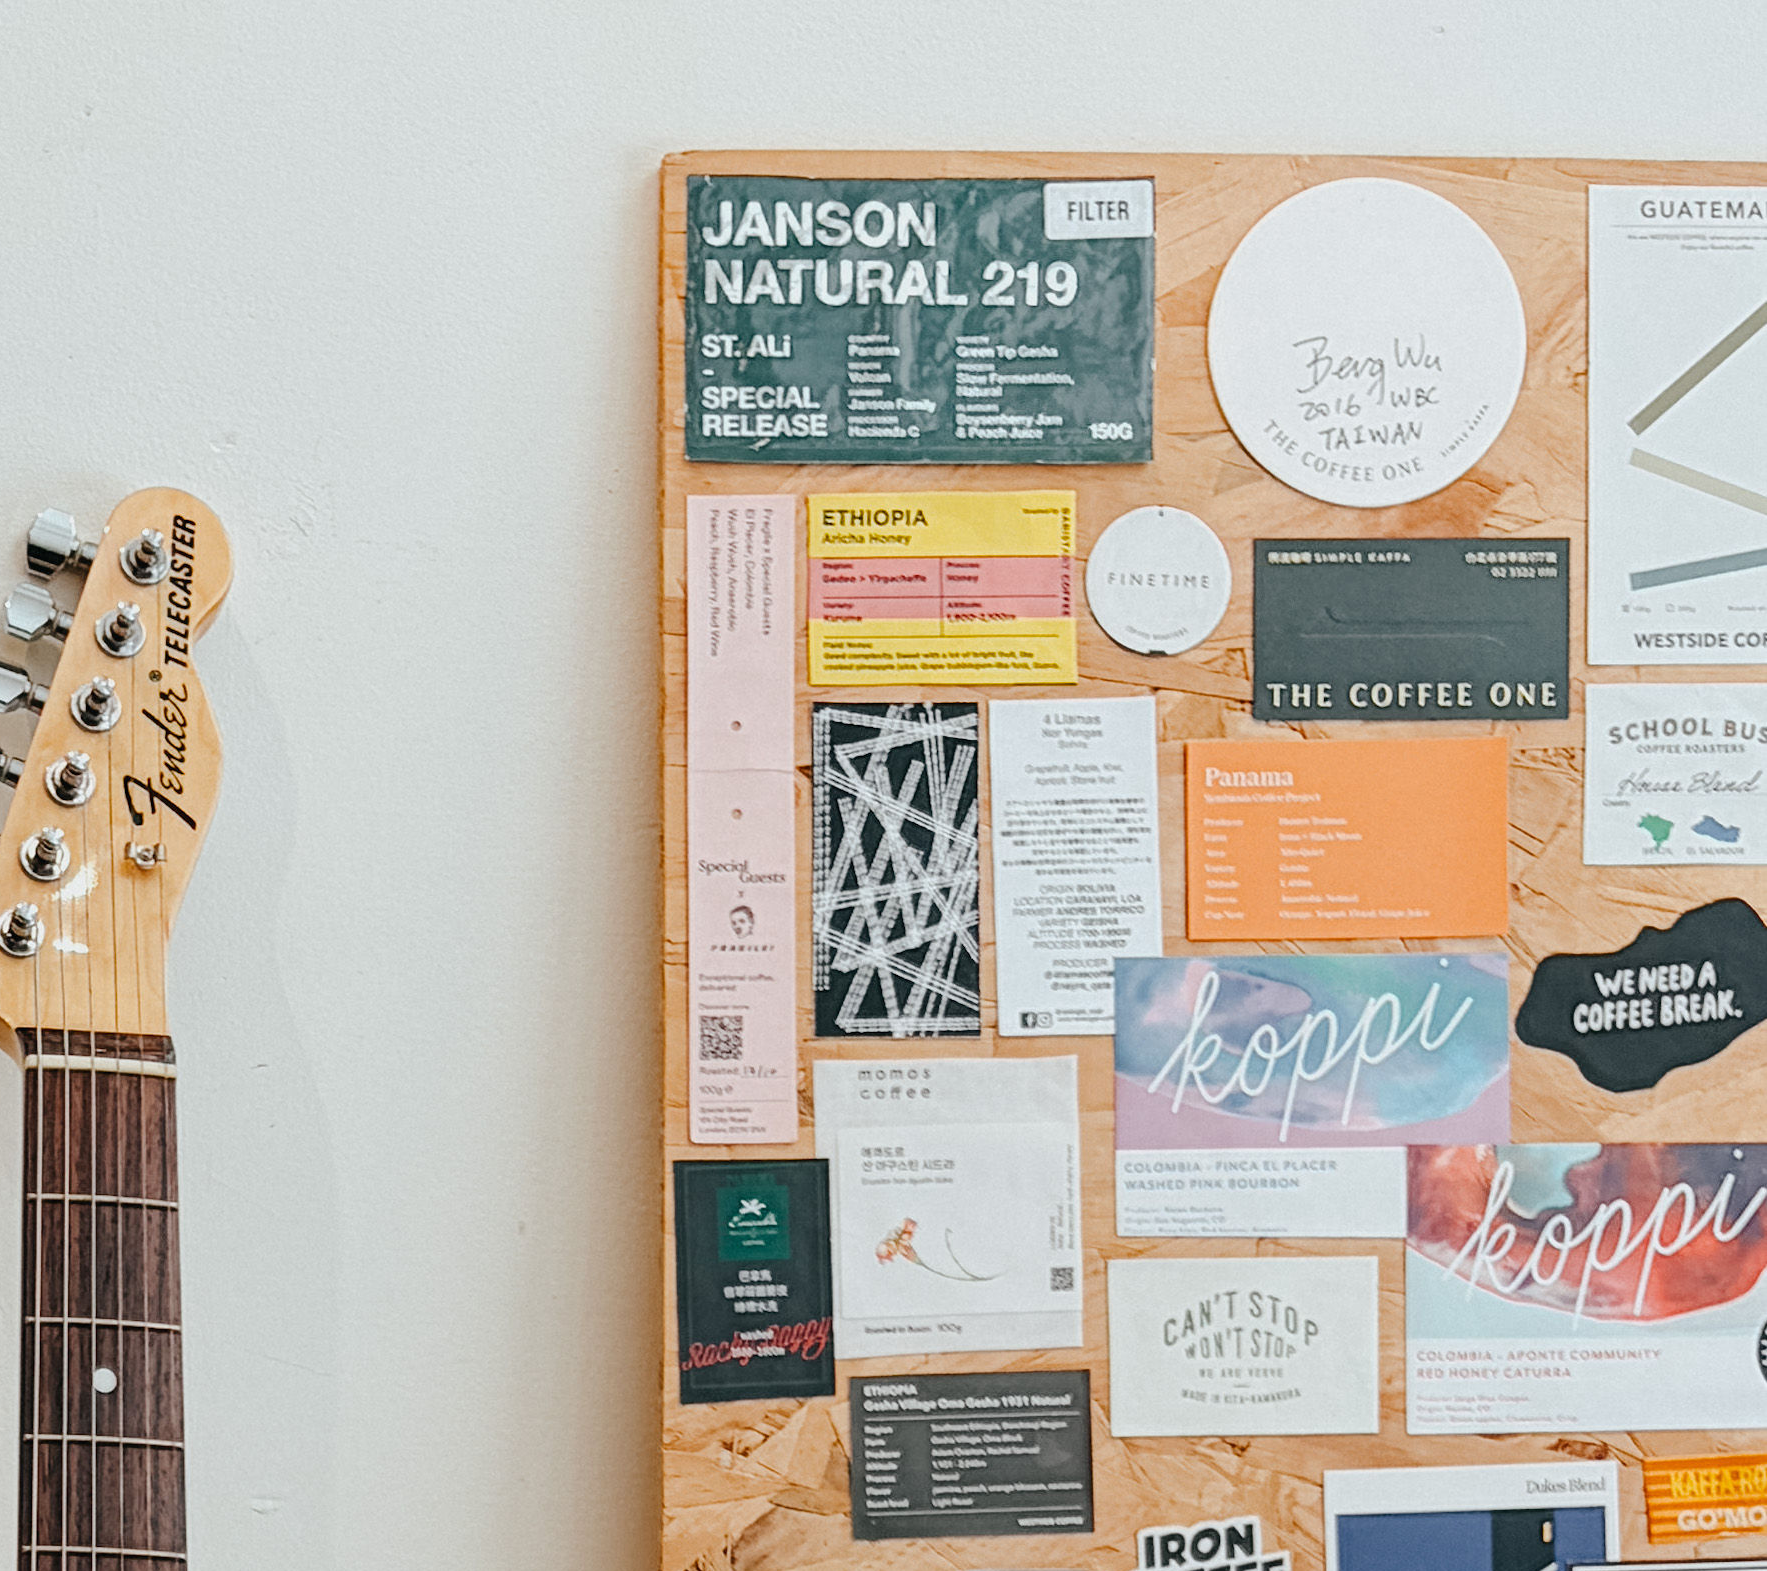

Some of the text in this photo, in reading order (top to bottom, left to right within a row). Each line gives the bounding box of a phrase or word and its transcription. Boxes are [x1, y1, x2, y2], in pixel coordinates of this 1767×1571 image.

[1067, 200, 1130, 222] FILTER
[1640, 200, 1767, 219] GUATEMA
[701, 200, 937, 248] JANSON
[703, 259, 1079, 307] NATURAL 219
[701, 335, 743, 358] ST.
[701, 386, 821, 410] SPECIAL
[1297, 393, 1362, 421] 2016
[701, 413, 1133, 441] RELEASE 150G
[1318, 421, 1424, 452] TAIWAN
[1262, 419, 1425, 483] THE COFFEE ONE
[822, 509, 928, 527] ETHIOPIA
[869, 533, 912, 546] Honey
[164, 514, 197, 668] TELECASTER
[1107, 572, 1210, 589] FINETIME
[1634, 632, 1729, 648] WESTSIDE
[1267, 681, 1557, 708] THE COFFEE ONE
[1608, 717, 1767, 745] SCHOOL BUS
[123, 682, 198, 831] Fender
[1636, 744, 1746, 754] COFFEE ROASTERS
[1205, 766, 1294, 788] Panama
[1595, 961, 1718, 998] WE NEED A
[1574, 989, 1743, 1034] COFFEE BREAK.
[1148, 958, 1474, 1143] koppi
[858, 1067, 931, 1081] momos
[860, 1086, 931, 1101] coffee
[1124, 1160, 1337, 1174] COLOMBIA FINCA EL PLACER
[1124, 1177, 1299, 1191] WASHED PINK BOURBON
[1443, 1148, 1767, 1331] koppi
[1163, 1290, 1319, 1346] CAN'T STOP
[1185, 1326, 1297, 1358] WON'T STOP
[1416, 1348, 1662, 1362] COLOMBIA APONTE COMMUNITY
[1416, 1366, 1572, 1379] RED HONEY CATURRA
[863, 1384, 918, 1397] ETHIOPIA
[1526, 1476, 1606, 1495] Dukes Blend
[1144, 1522, 1255, 1569] IRON
